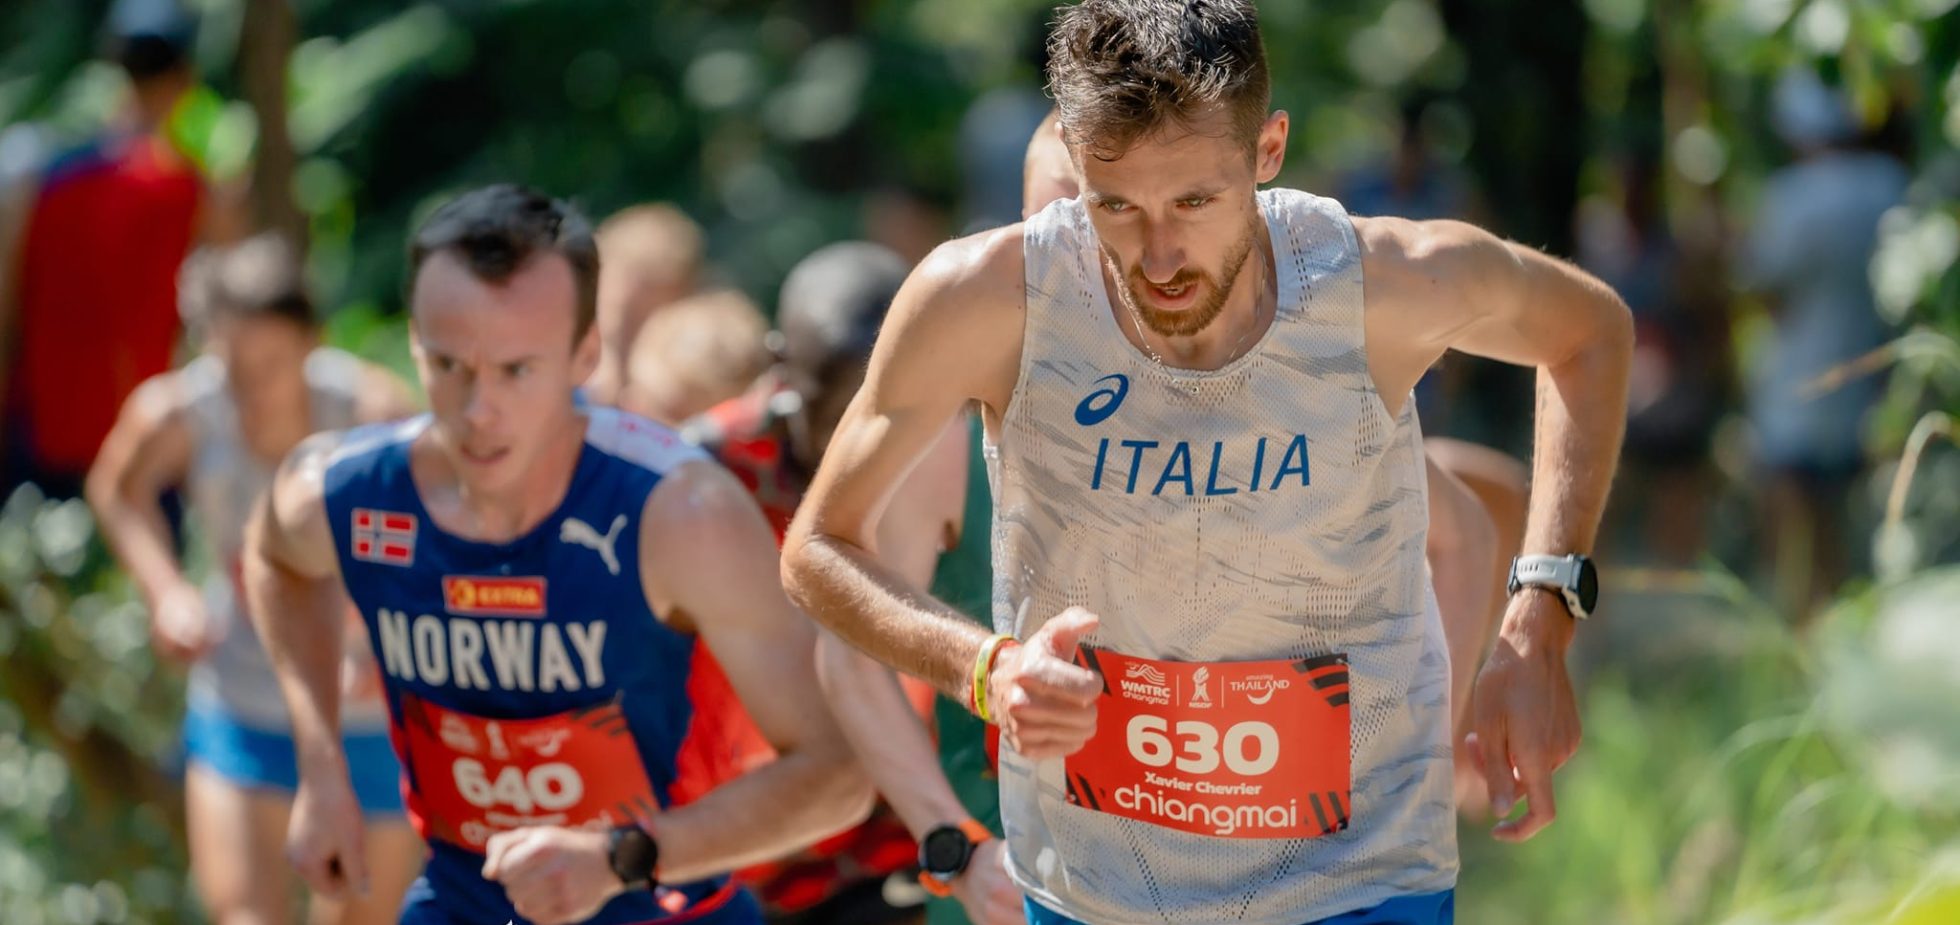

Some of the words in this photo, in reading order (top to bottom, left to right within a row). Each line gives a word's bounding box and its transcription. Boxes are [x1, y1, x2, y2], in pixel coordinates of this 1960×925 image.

[1091, 434, 1310, 496] ITALIA
[478, 586, 539, 607] EXTRA
[377, 607, 608, 694] NORWAY
[1121, 680, 1171, 698] WMTRC
[1122, 690, 1169, 706] chiangmai
[1229, 679, 1290, 692] THAILAND
[1126, 714, 1280, 776] 630
[452, 757, 584, 814] 640
[1145, 771, 1193, 792] Xavier
[1195, 781, 1262, 795] Chevrier
[1114, 784, 1297, 835] chiangmai
